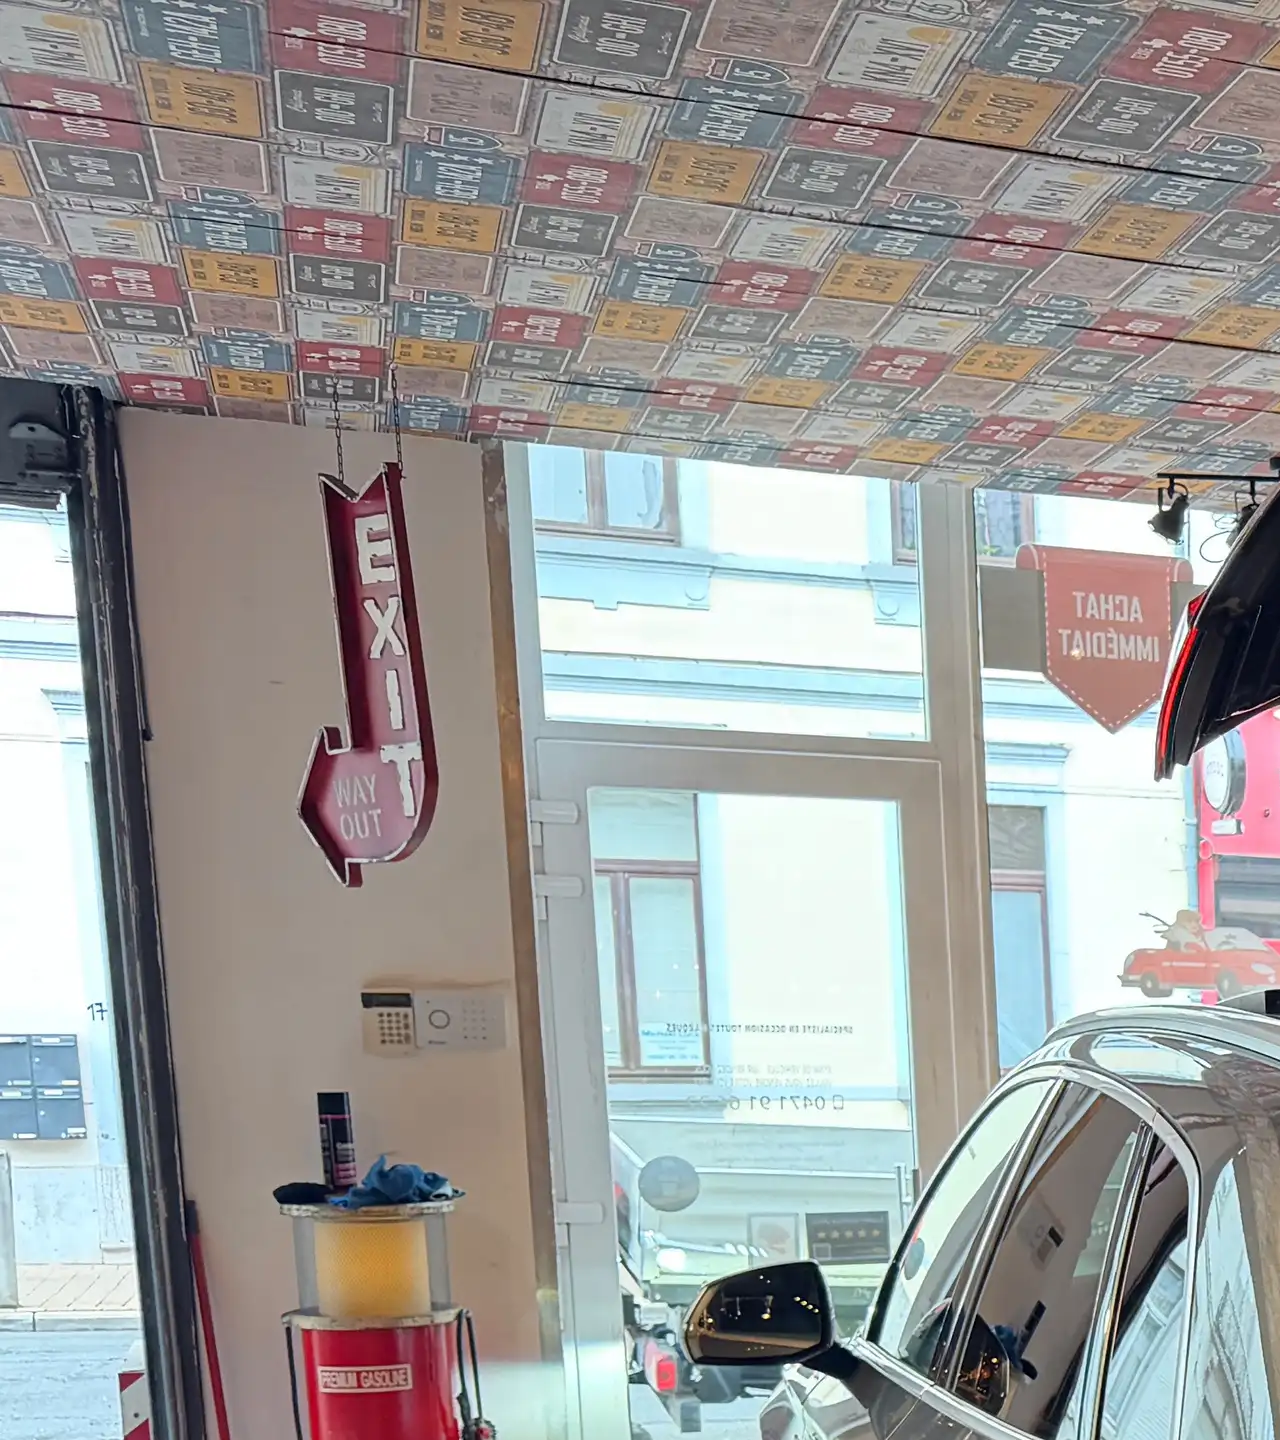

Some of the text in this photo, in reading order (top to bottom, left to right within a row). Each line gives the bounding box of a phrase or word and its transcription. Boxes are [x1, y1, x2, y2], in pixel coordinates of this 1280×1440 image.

[355, 512, 422, 817] EXIT
[332, 773, 379, 809] WAY
[339, 808, 382, 841] OUT
[87, 1003, 108, 1021] 17
[361, 1366, 409, 1388] GASOLINE
